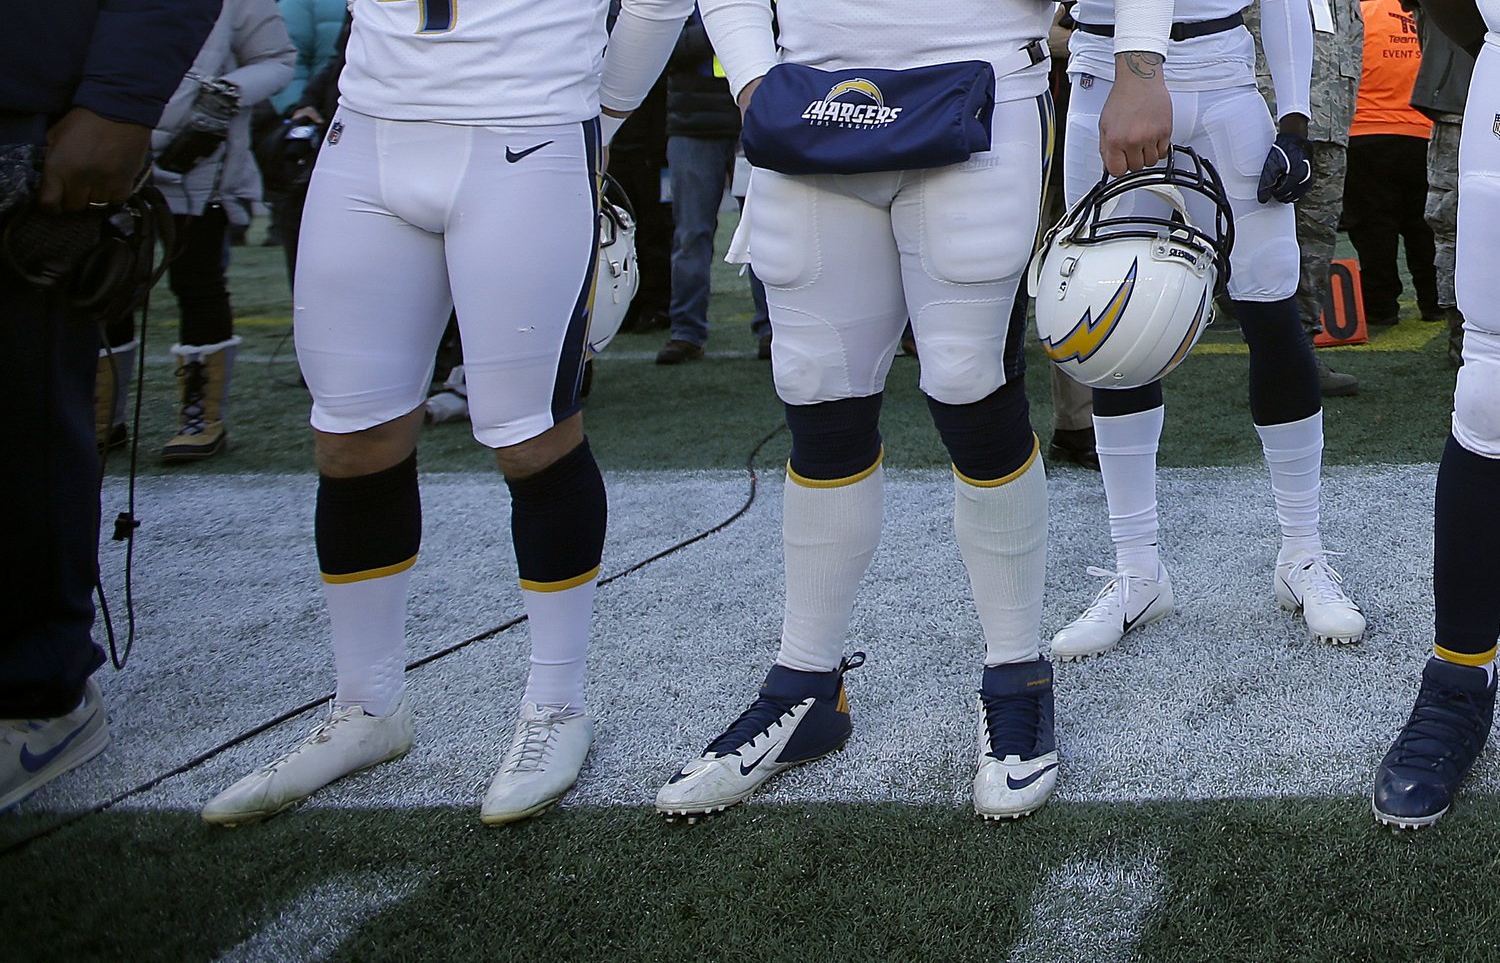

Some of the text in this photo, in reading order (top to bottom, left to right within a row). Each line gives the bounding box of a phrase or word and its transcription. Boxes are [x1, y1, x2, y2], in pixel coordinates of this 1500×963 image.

[1382, 49, 1422, 59] EVENT S
[801, 99, 904, 125] CHARGERS
